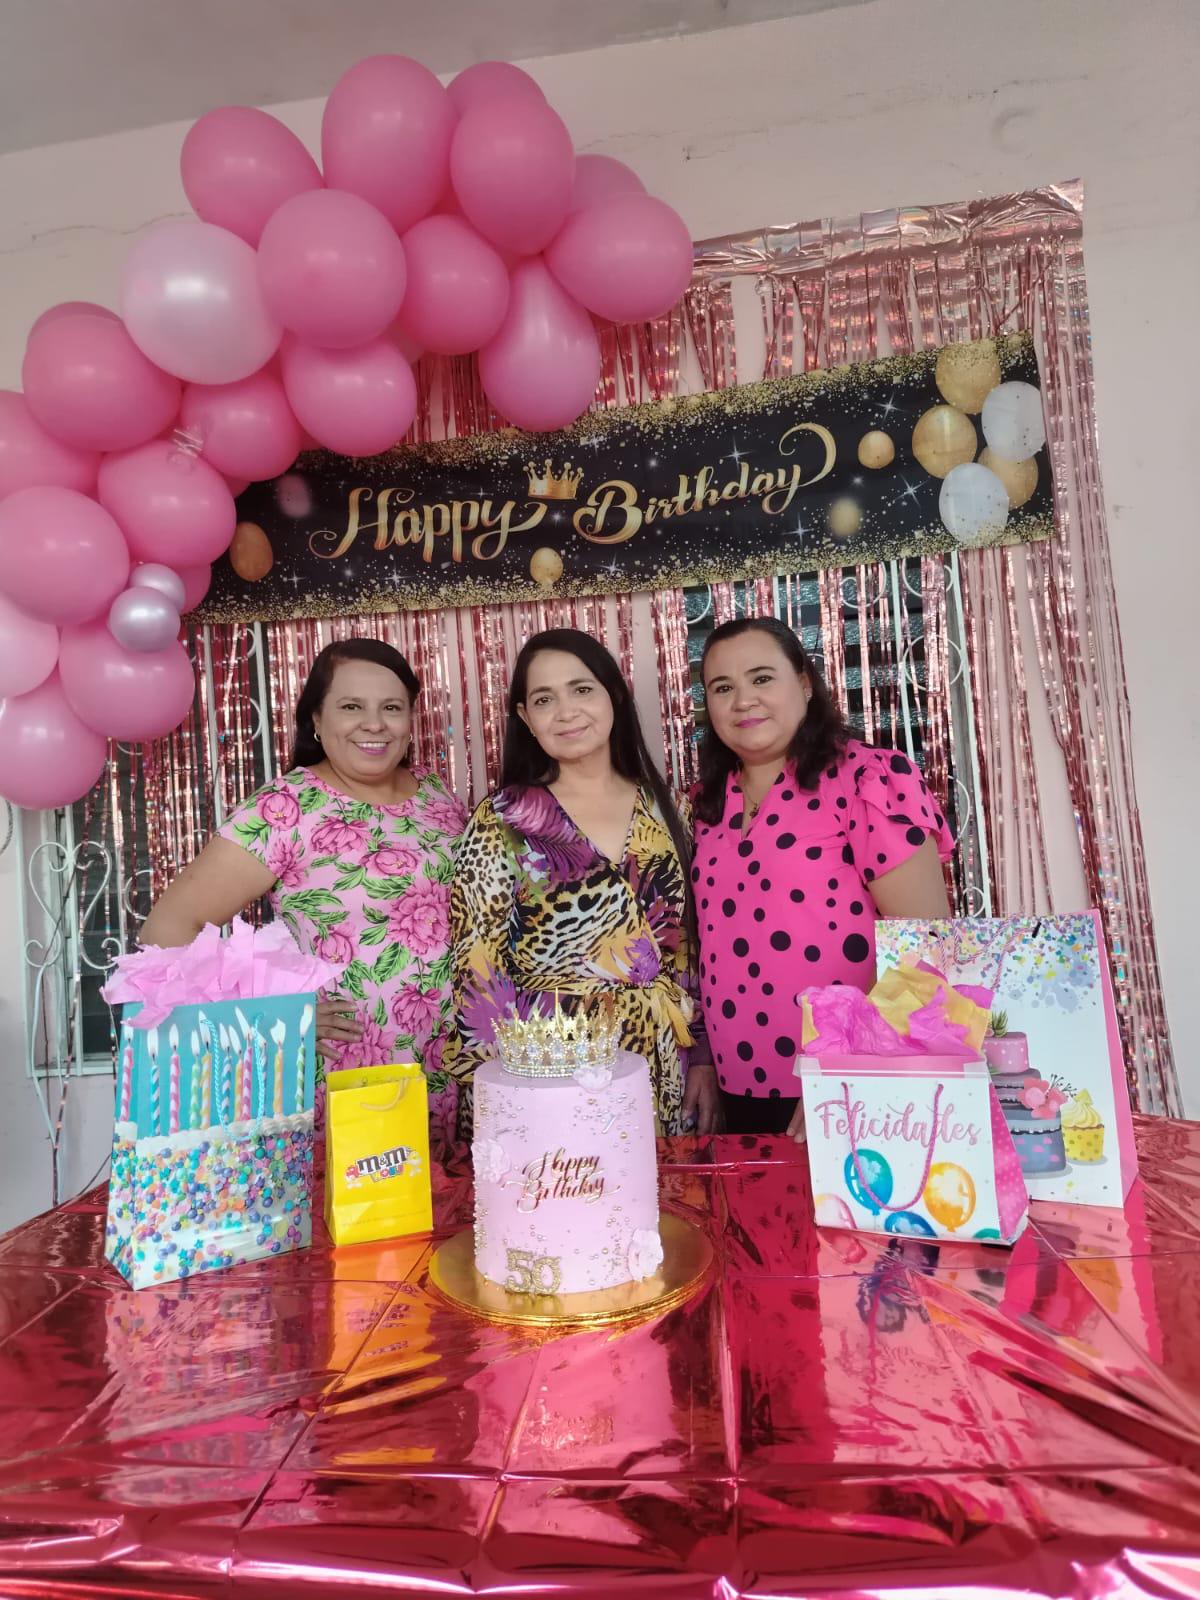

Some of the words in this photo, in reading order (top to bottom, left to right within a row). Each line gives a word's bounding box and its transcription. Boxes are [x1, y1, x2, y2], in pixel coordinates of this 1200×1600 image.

[309, 487, 548, 563] Happy
[573, 422, 837, 545] Birthday
[814, 1099, 982, 1149] Felicidades
[522, 1147, 604, 1180] Happy
[501, 1174, 620, 1213] Birthday
[506, 1248, 561, 1295] 50
